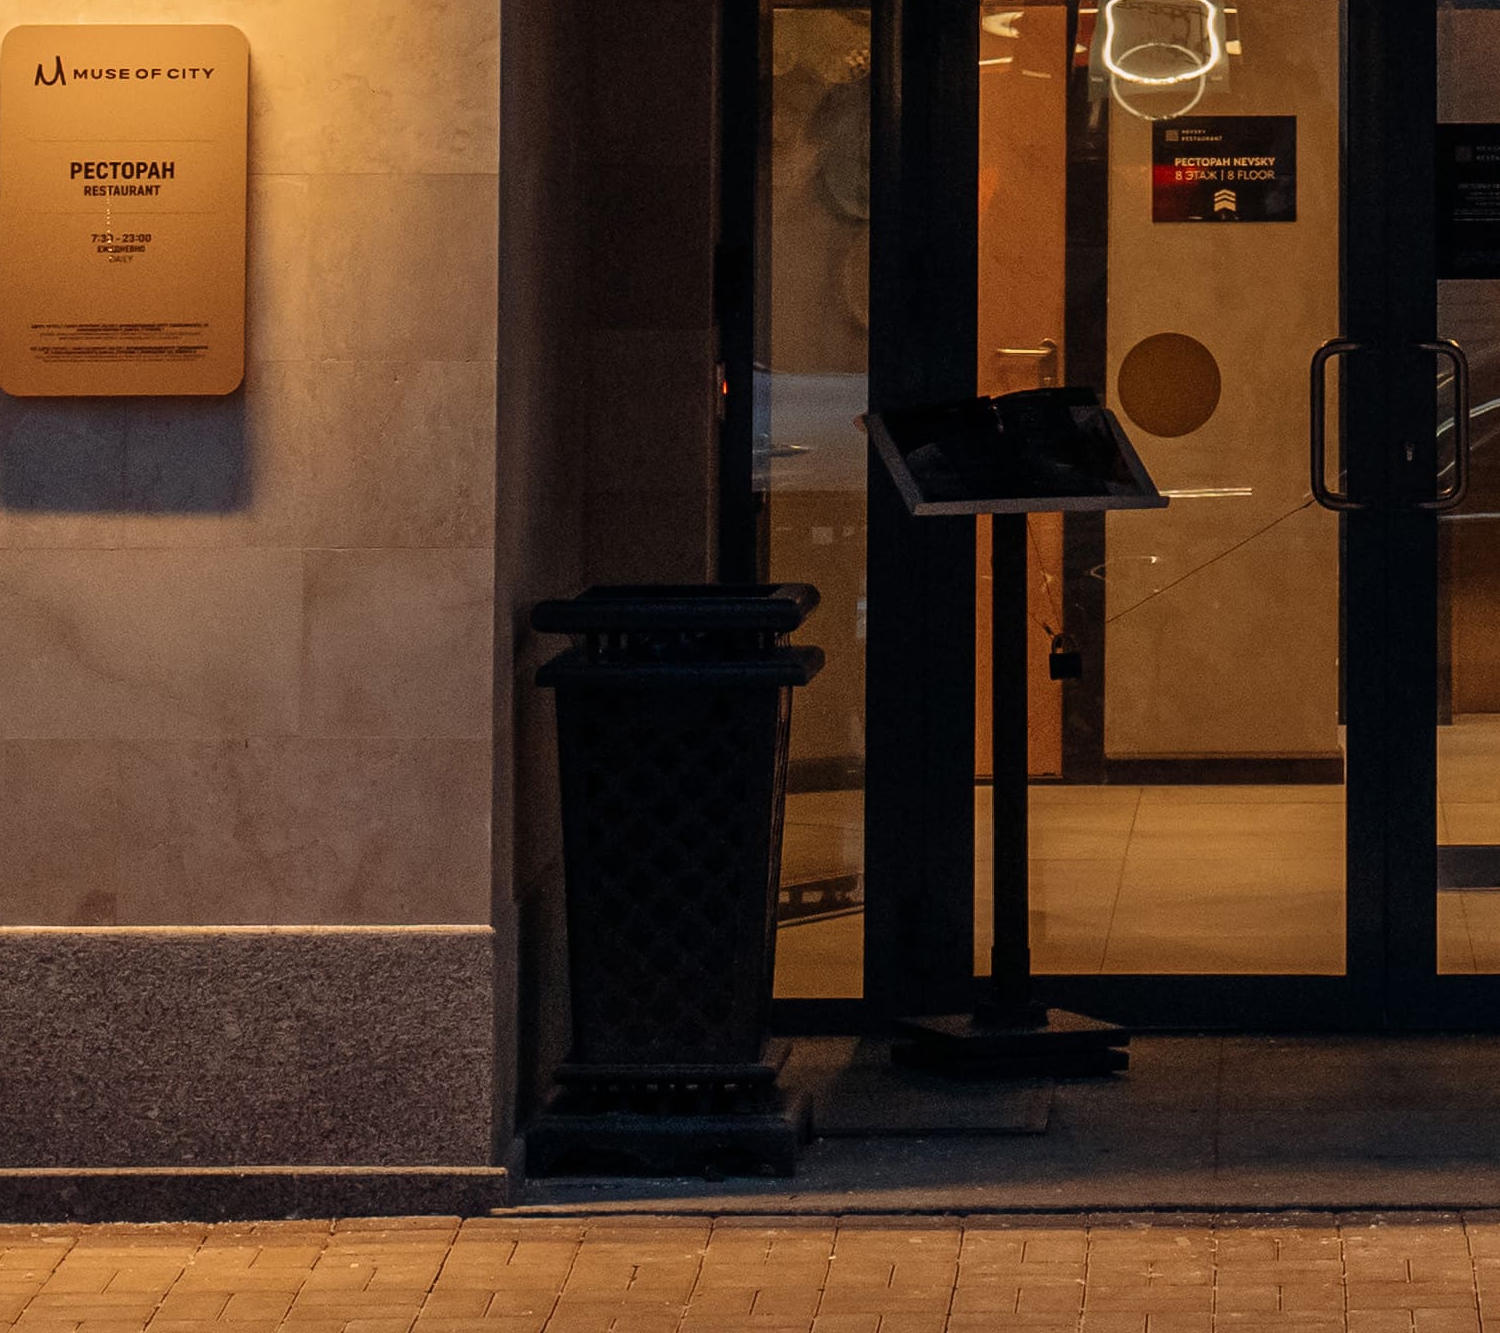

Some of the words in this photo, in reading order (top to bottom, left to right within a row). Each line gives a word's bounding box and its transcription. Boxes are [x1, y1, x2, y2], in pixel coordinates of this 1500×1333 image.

[73, 68, 130, 80] MUSE
[135, 68, 162, 80] OF
[166, 68, 215, 80] CITY
[1174, 157, 1230, 167] РЕСТОРАН
[1233, 157, 1276, 167] NEVSKY
[70, 162, 175, 179] РЕСТОРАН
[1175, 170, 1182, 180] 8
[1185, 170, 1218, 180] ЭТАЖ
[1227, 170, 1235, 180] 8
[1237, 170, 1276, 180] FLOOR
[83, 185, 161, 196] RESTAURANT
[122, 233, 152, 243] 23:00
